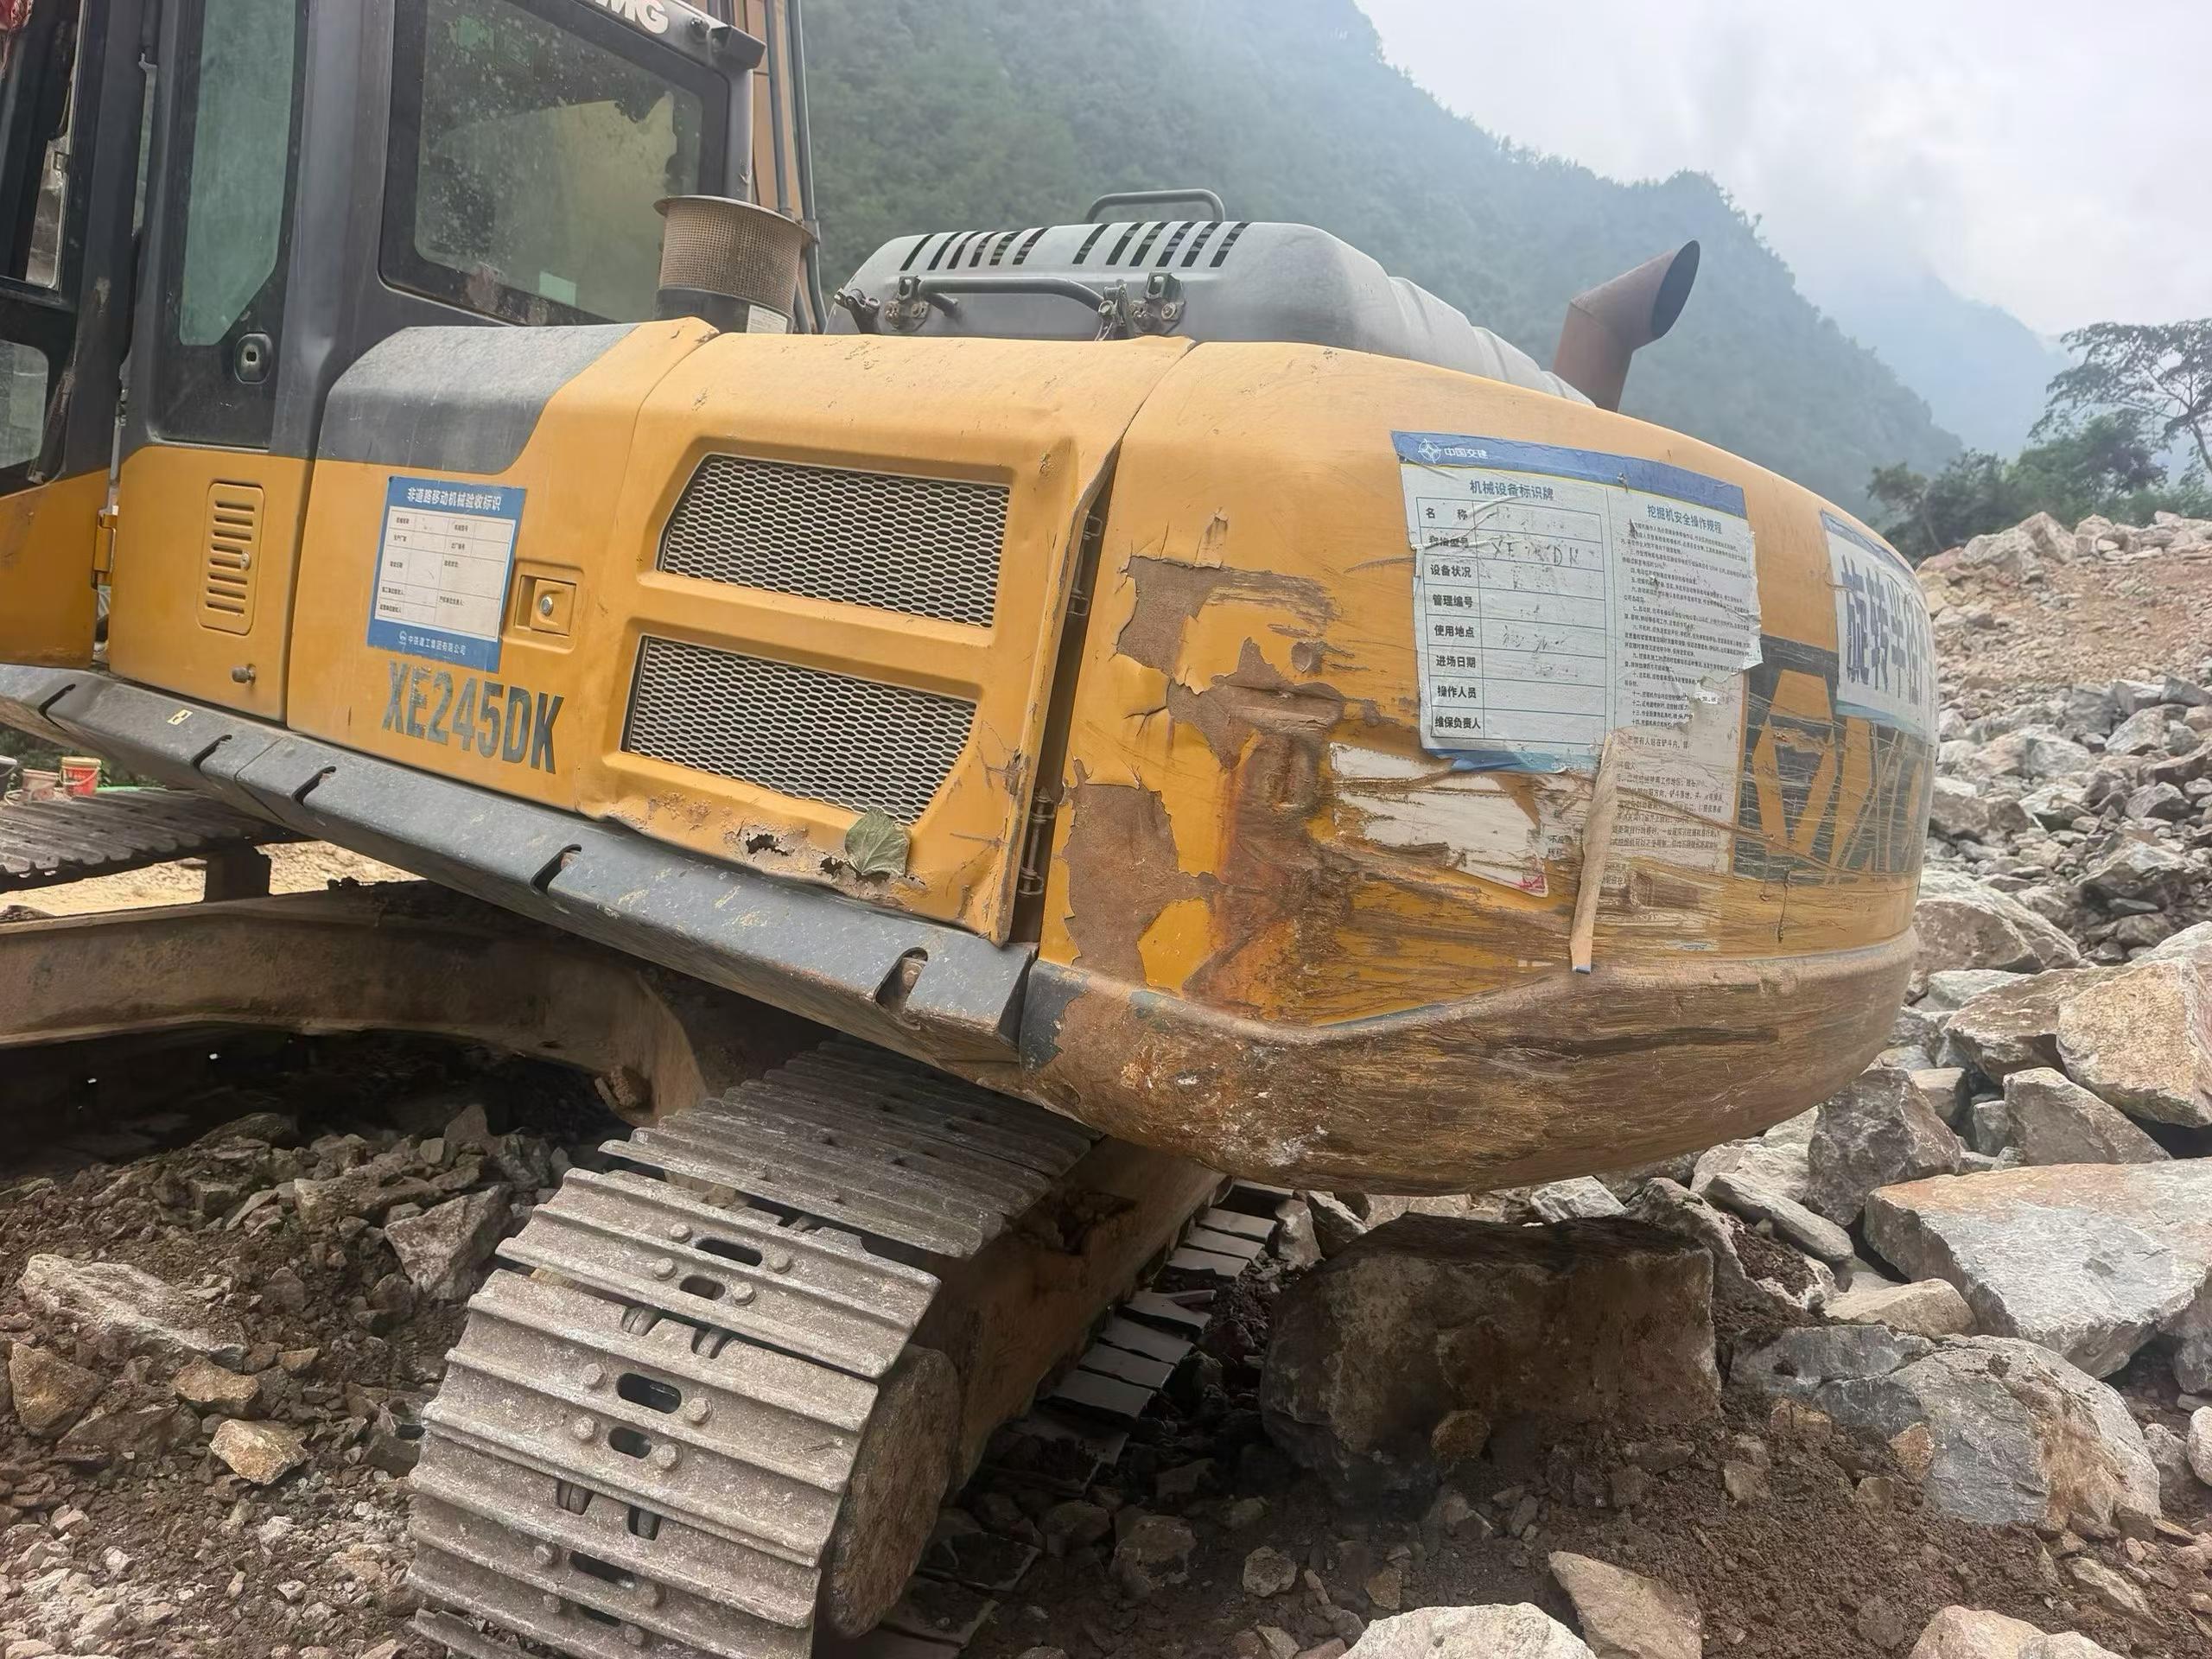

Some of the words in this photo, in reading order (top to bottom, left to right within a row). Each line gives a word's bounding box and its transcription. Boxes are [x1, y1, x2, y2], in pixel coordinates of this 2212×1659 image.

[1444, 448, 1488, 459] 中国交建
[1470, 479, 1554, 501] 机械设备标识牌
[407, 486, 501, 512] 非道路移动机械验收标识
[1647, 504, 1722, 535] 挖掘机安全操作规程
[1430, 564, 1471, 578] 设备状况
[1433, 594, 1473, 607] 管理编号
[1434, 624, 1475, 638] 使用地点
[1436, 655, 1476, 668] 进场日期
[1437, 685, 1477, 699] 操作人员
[382, 660, 564, 774] XE245DK
[1434, 716, 1481, 729] 维保负责人
